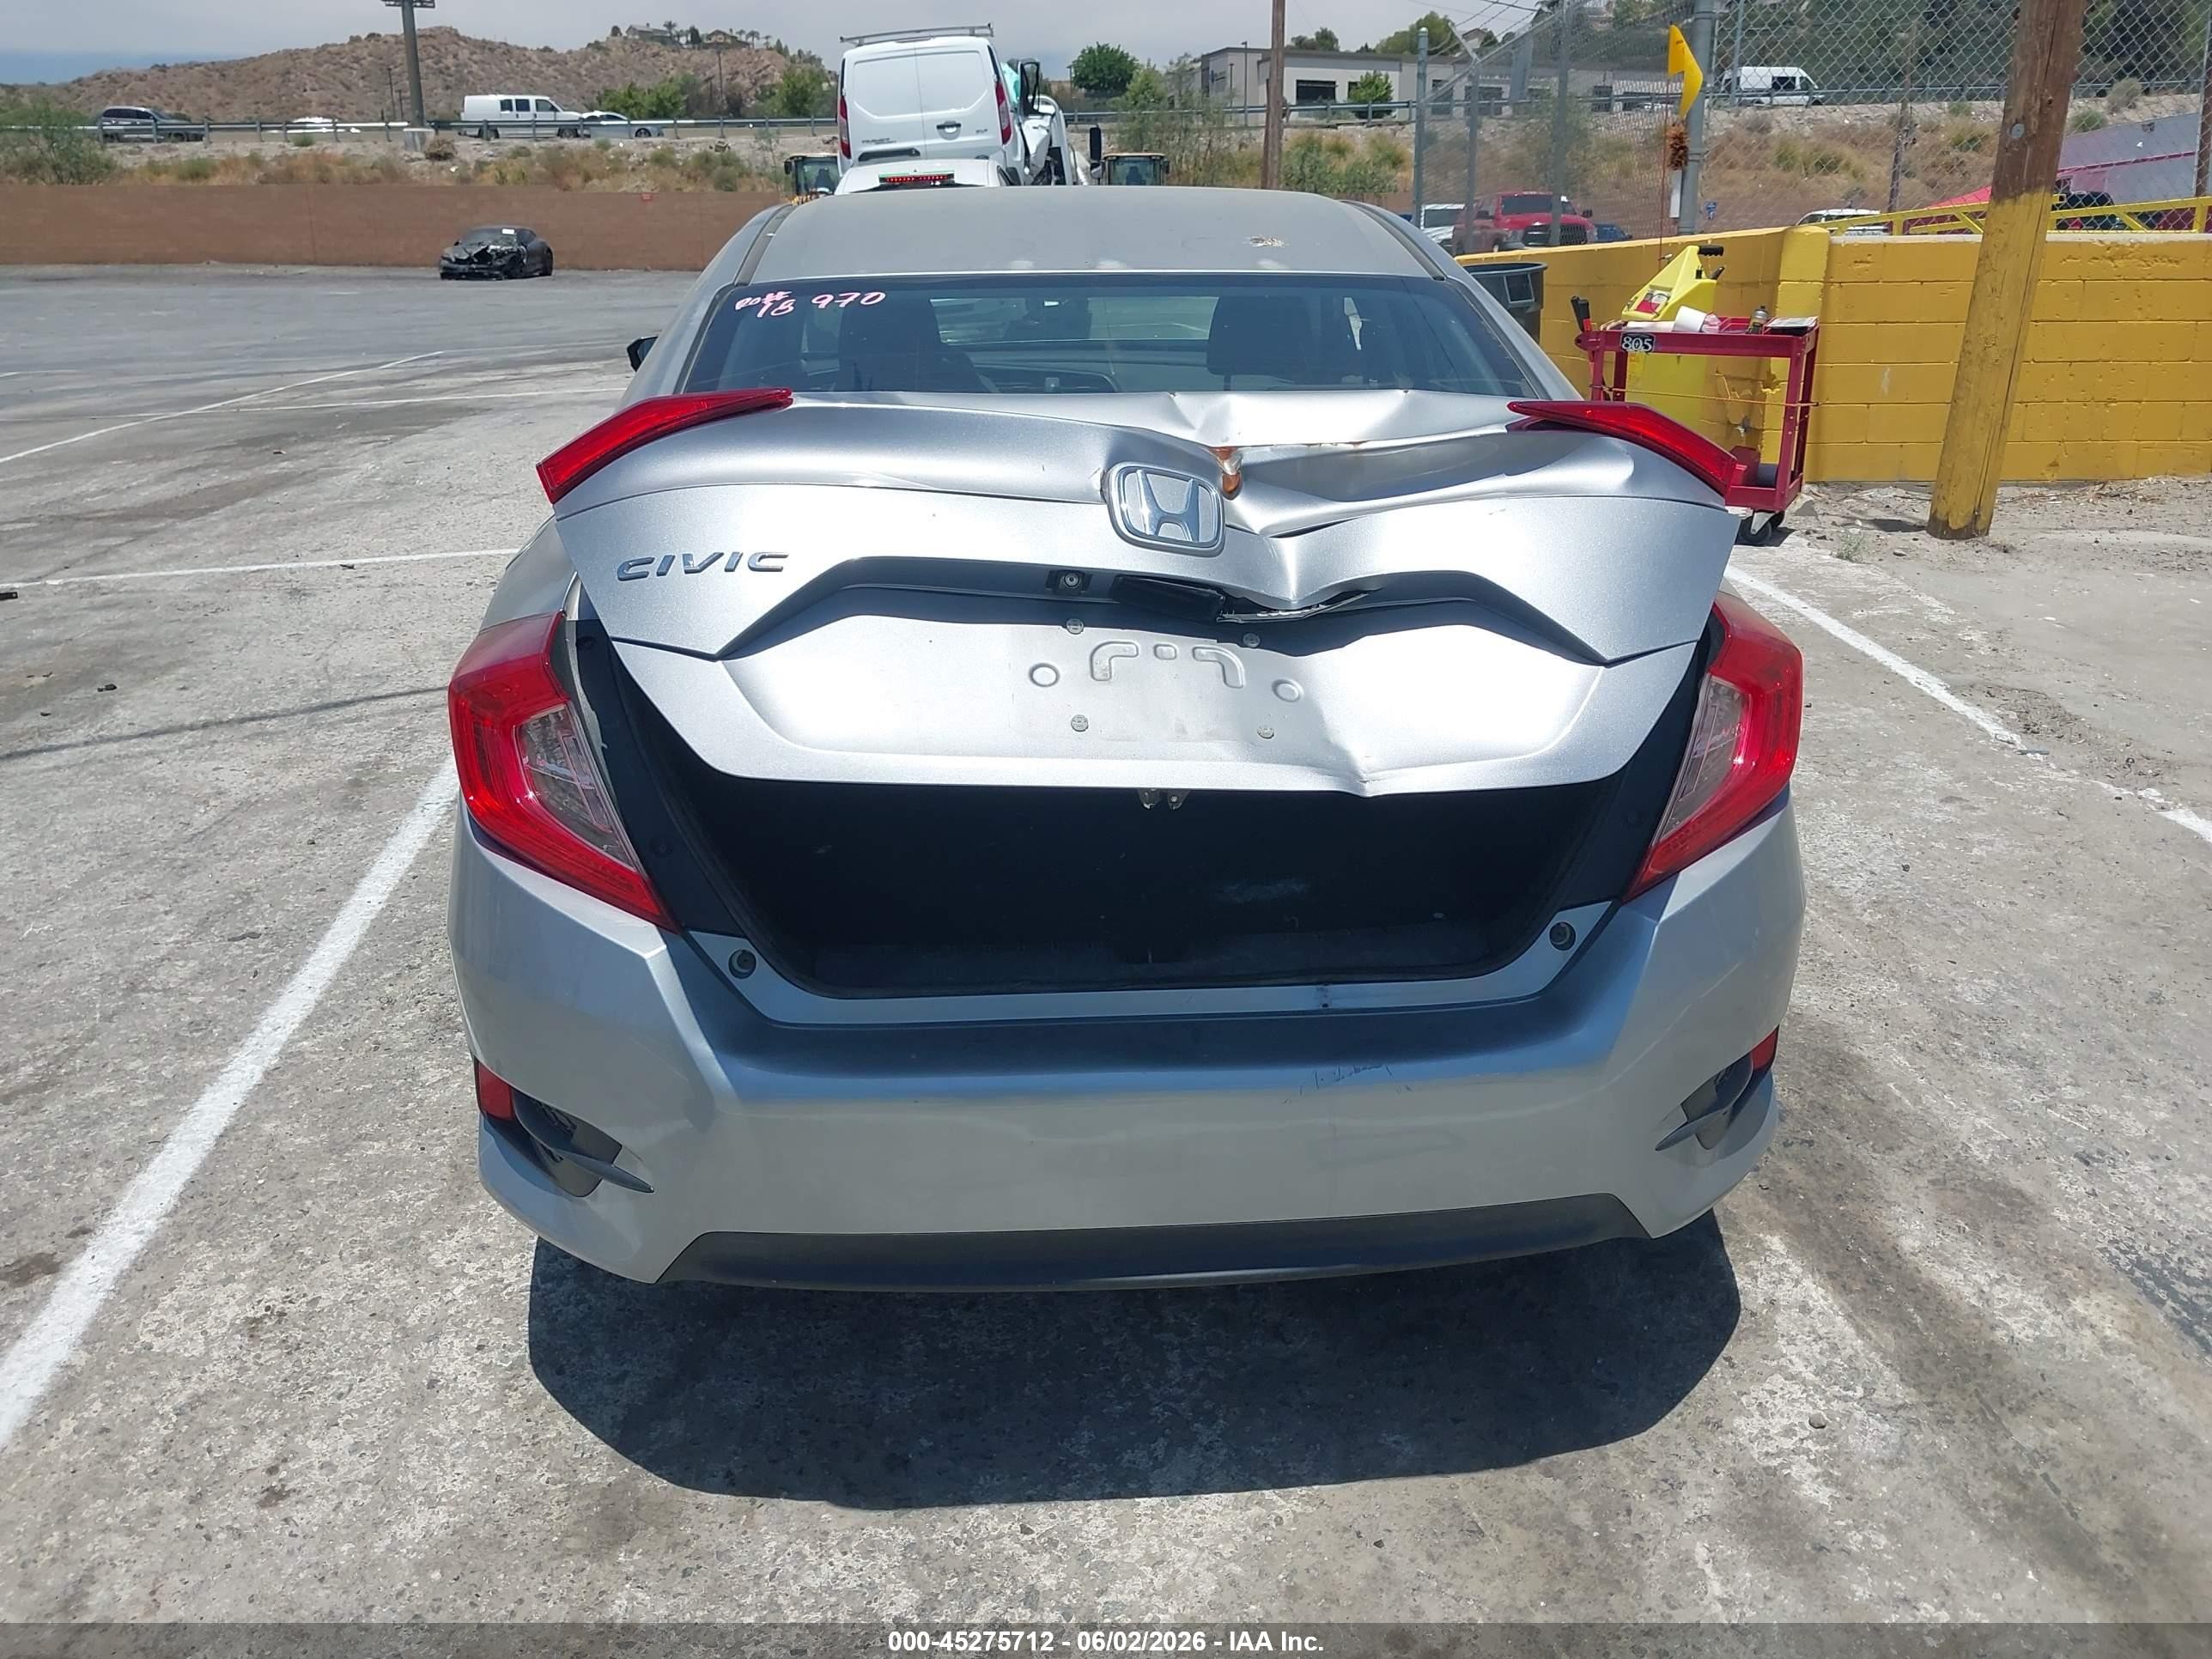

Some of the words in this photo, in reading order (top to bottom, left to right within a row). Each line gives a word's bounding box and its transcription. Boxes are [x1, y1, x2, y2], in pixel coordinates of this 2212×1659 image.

[811, 291, 886, 308] 970
[1621, 336, 1653, 352] 805
[617, 551, 788, 582] CIVIC
